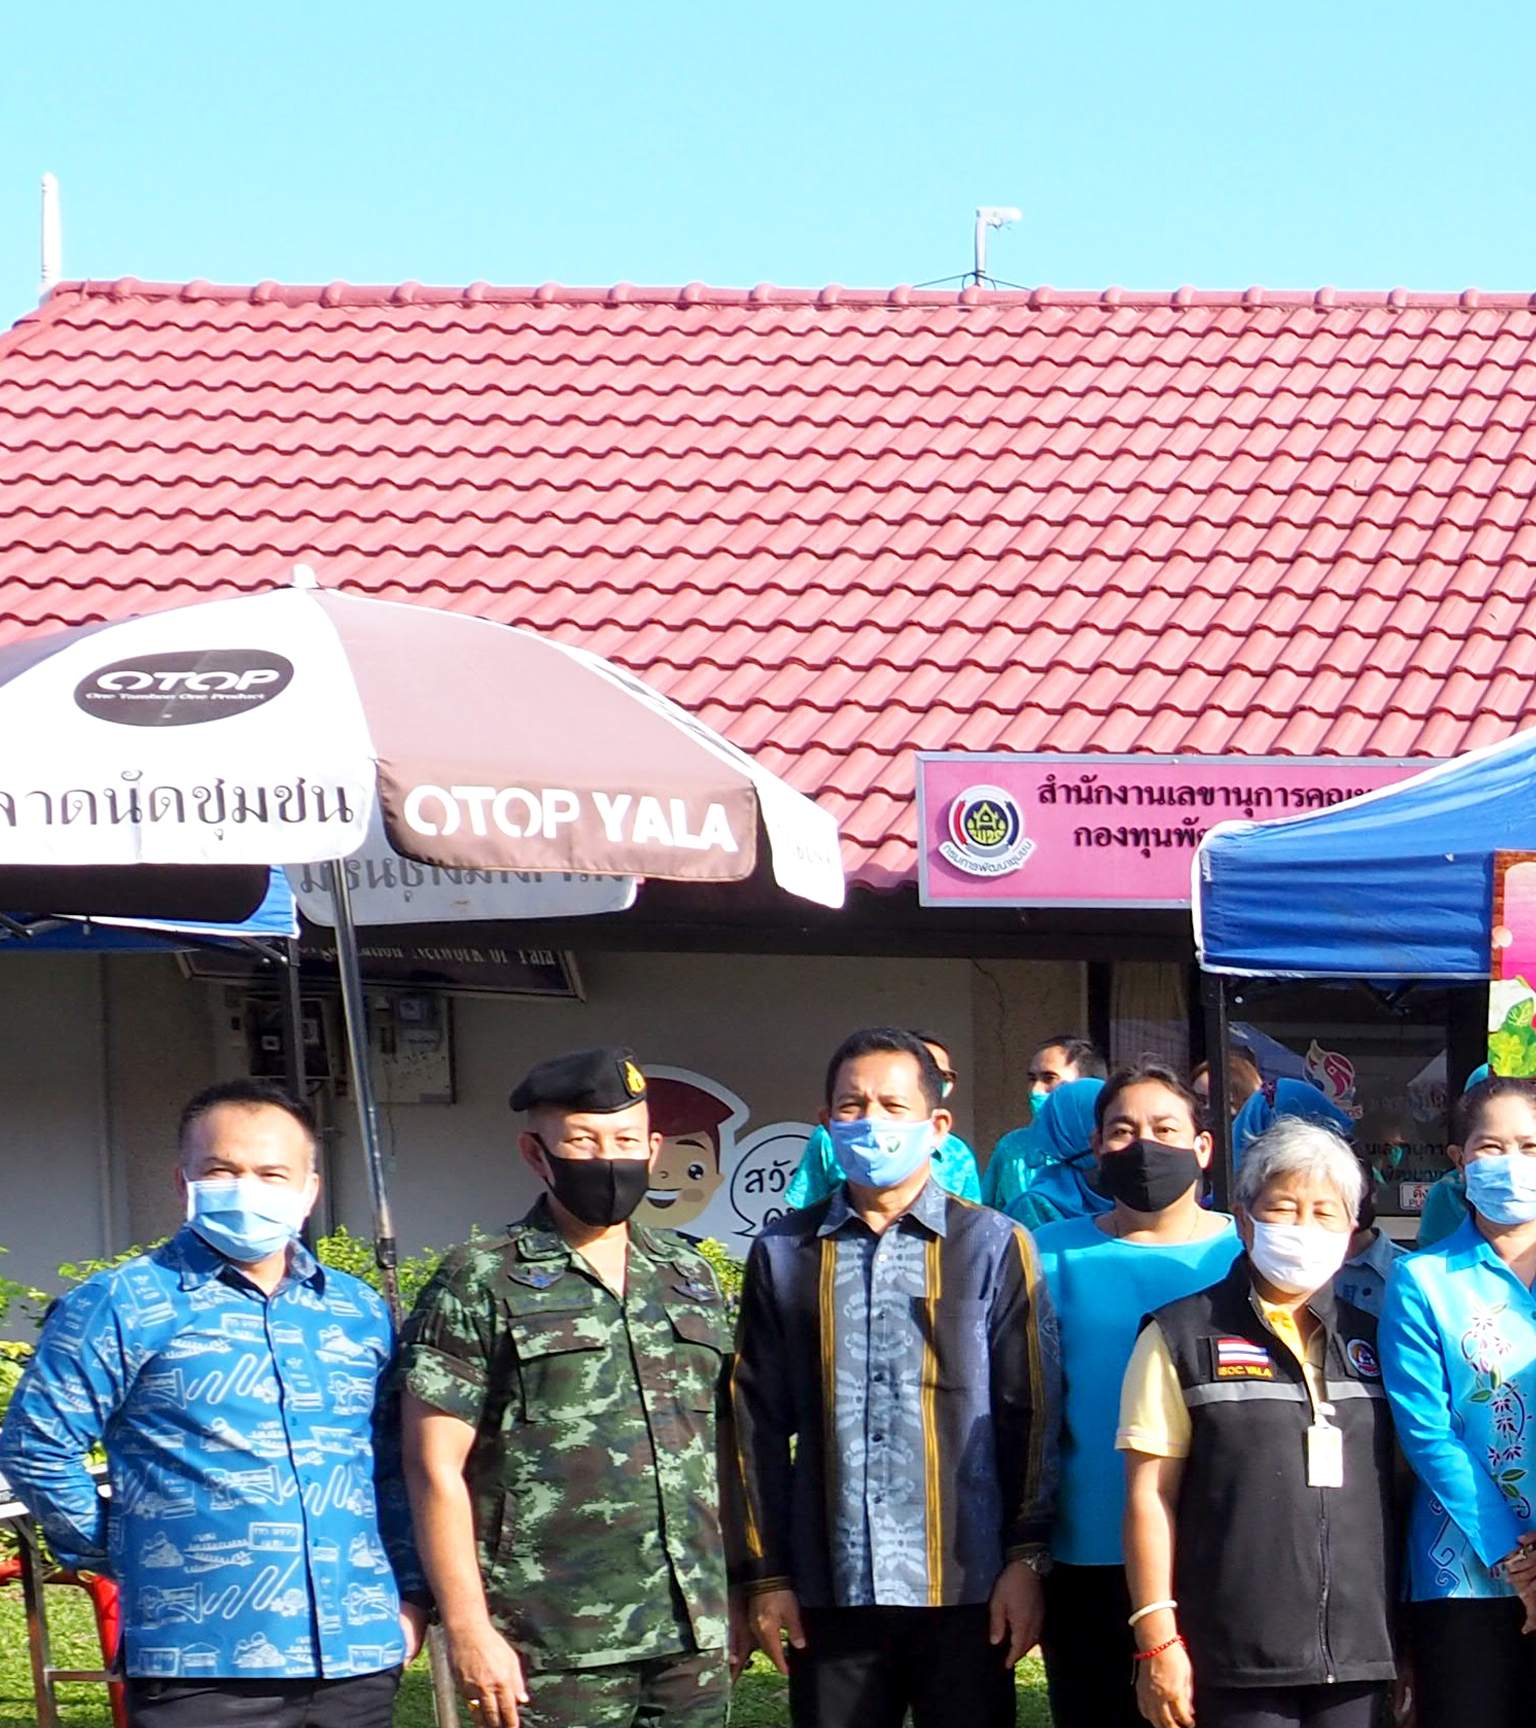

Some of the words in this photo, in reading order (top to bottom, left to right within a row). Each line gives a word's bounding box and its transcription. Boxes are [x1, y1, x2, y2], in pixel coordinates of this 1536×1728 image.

[97, 669, 280, 690] OTOP
[403, 784, 581, 838] OTOP
[591, 791, 739, 853] YALA
